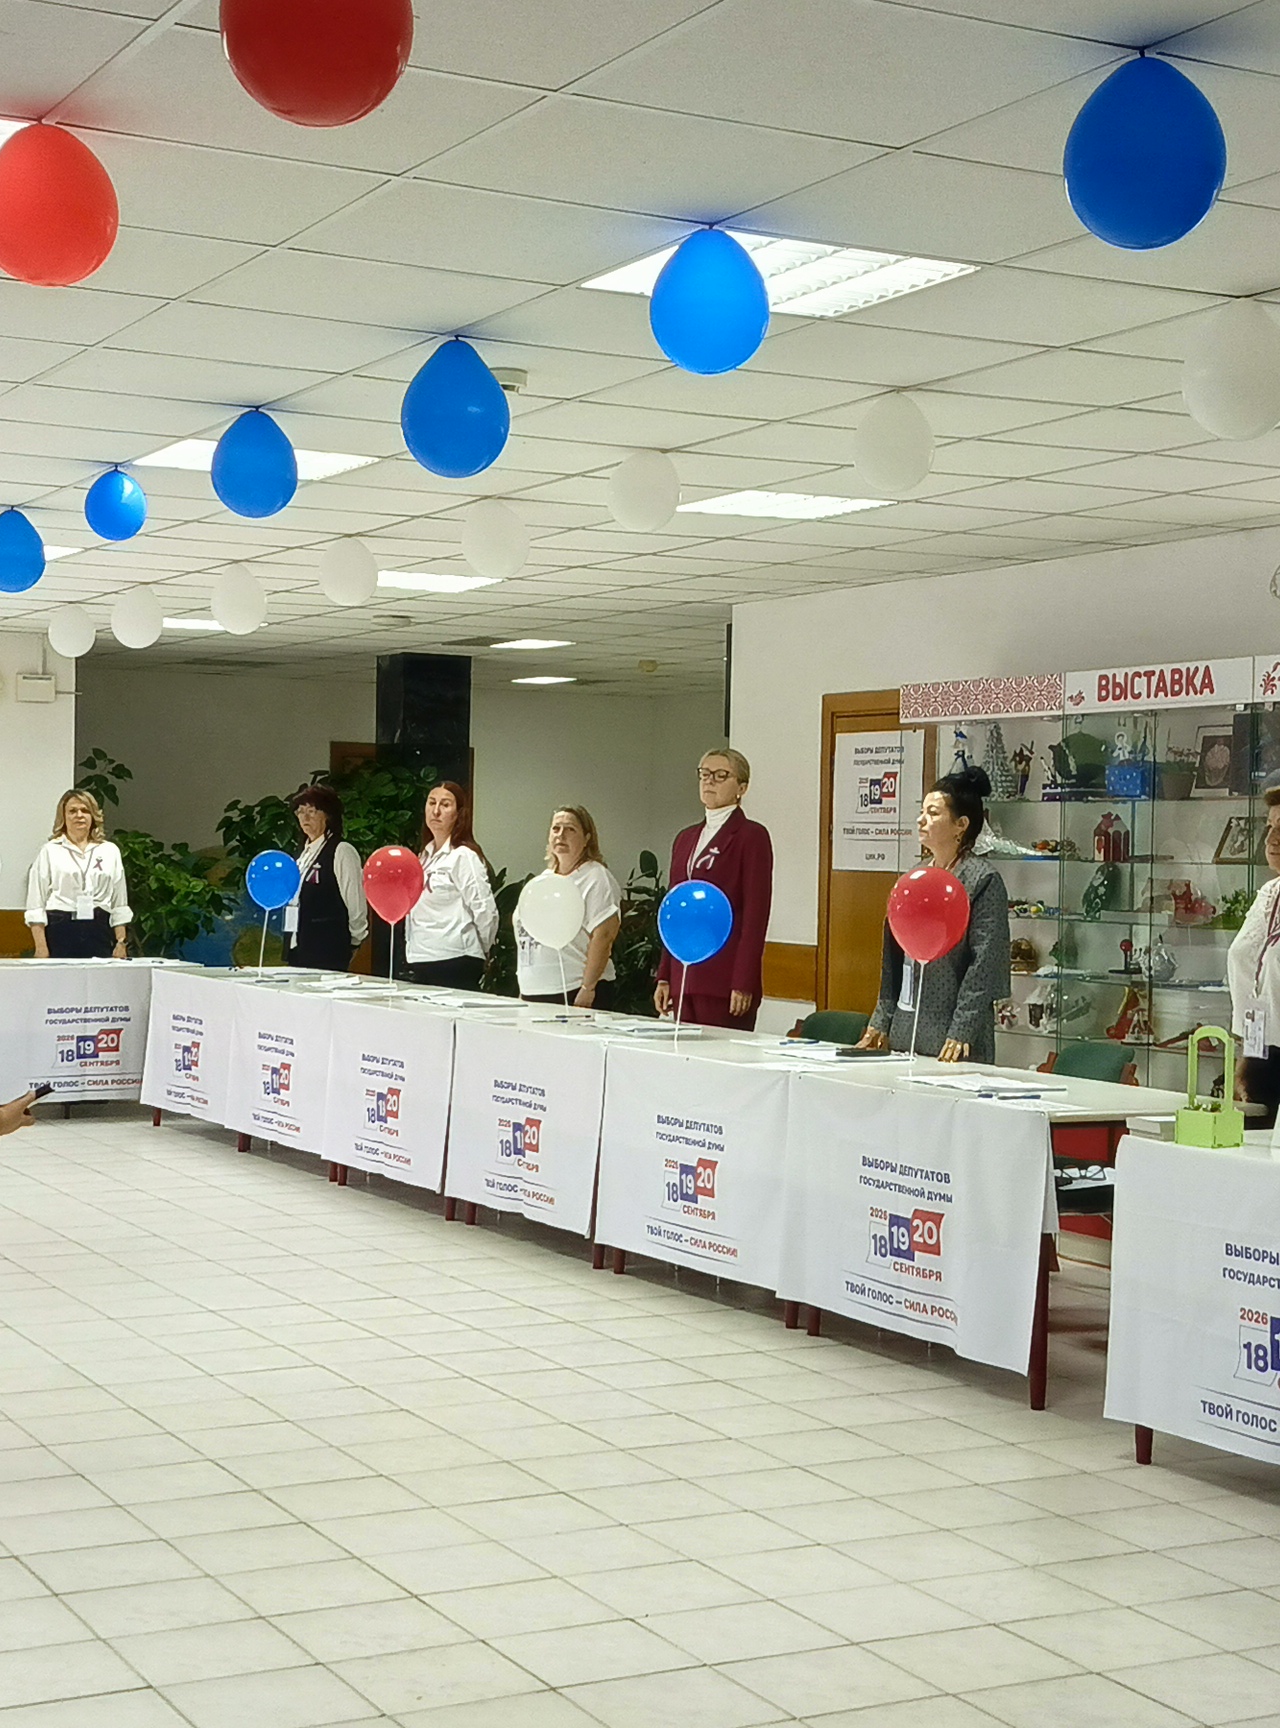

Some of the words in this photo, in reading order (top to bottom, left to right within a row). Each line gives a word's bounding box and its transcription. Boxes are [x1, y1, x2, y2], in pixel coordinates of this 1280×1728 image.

[1097, 665, 1215, 702] ВЫСТАВКА
[860, 793, 869, 808] 18
[870, 785, 880, 799] 19
[882, 778, 895, 793] 20
[83, 1006, 130, 1014] ДЕПУТАТОВ
[58, 1049, 75, 1062] 18
[78, 1040, 94, 1054] 19
[98, 1034, 117, 1047] 20
[111, 1078, 142, 1086] РОССИИ
[387, 1094, 398, 1112] 20
[657, 1114, 684, 1128] ВЫБОРЫ
[685, 1119, 723, 1135] ДЕПУТАТОВ
[499, 1139, 512, 1157] 18
[524, 1125, 538, 1145] 20
[862, 1155, 897, 1173] ВЫБОРЫ
[898, 1164, 951, 1184] ДЕПУТАТОВ
[666, 1181, 679, 1202] 18
[681, 1173, 695, 1195] 19
[697, 1167, 713, 1189] 20
[859, 1175, 925, 1199] ГОСУДАРСТВЕННОЙ
[927, 1190, 953, 1203] ДУМЫ
[682, 1204, 716, 1221] СЕНТЯБРЯ
[870, 1207, 888, 1221] 2026
[646, 1224, 662, 1238] ТВОЙ
[663, 1229, 683, 1243] ГОЛОС
[690, 1236, 707, 1250] СИЛА
[872, 1233, 888, 1258] 18
[891, 1225, 909, 1250] 19
[912, 1219, 938, 1245] 20
[1225, 1243, 1280, 1265] ВЫБОРЫ
[893, 1261, 942, 1282] СЕНТЯБРЯ
[845, 1280, 866, 1296] ТВОЙ
[867, 1287, 893, 1306] ГОЛОС
[904, 1298, 928, 1315] СИЛА
[931, 1305, 958, 1326] РОСС
[1239, 1308, 1268, 1325] 2026
[1243, 1342, 1268, 1373] 18
[1200, 1400, 1233, 1420] ТВОЙ
[1236, 1410, 1277, 1432] ГОЛОС
